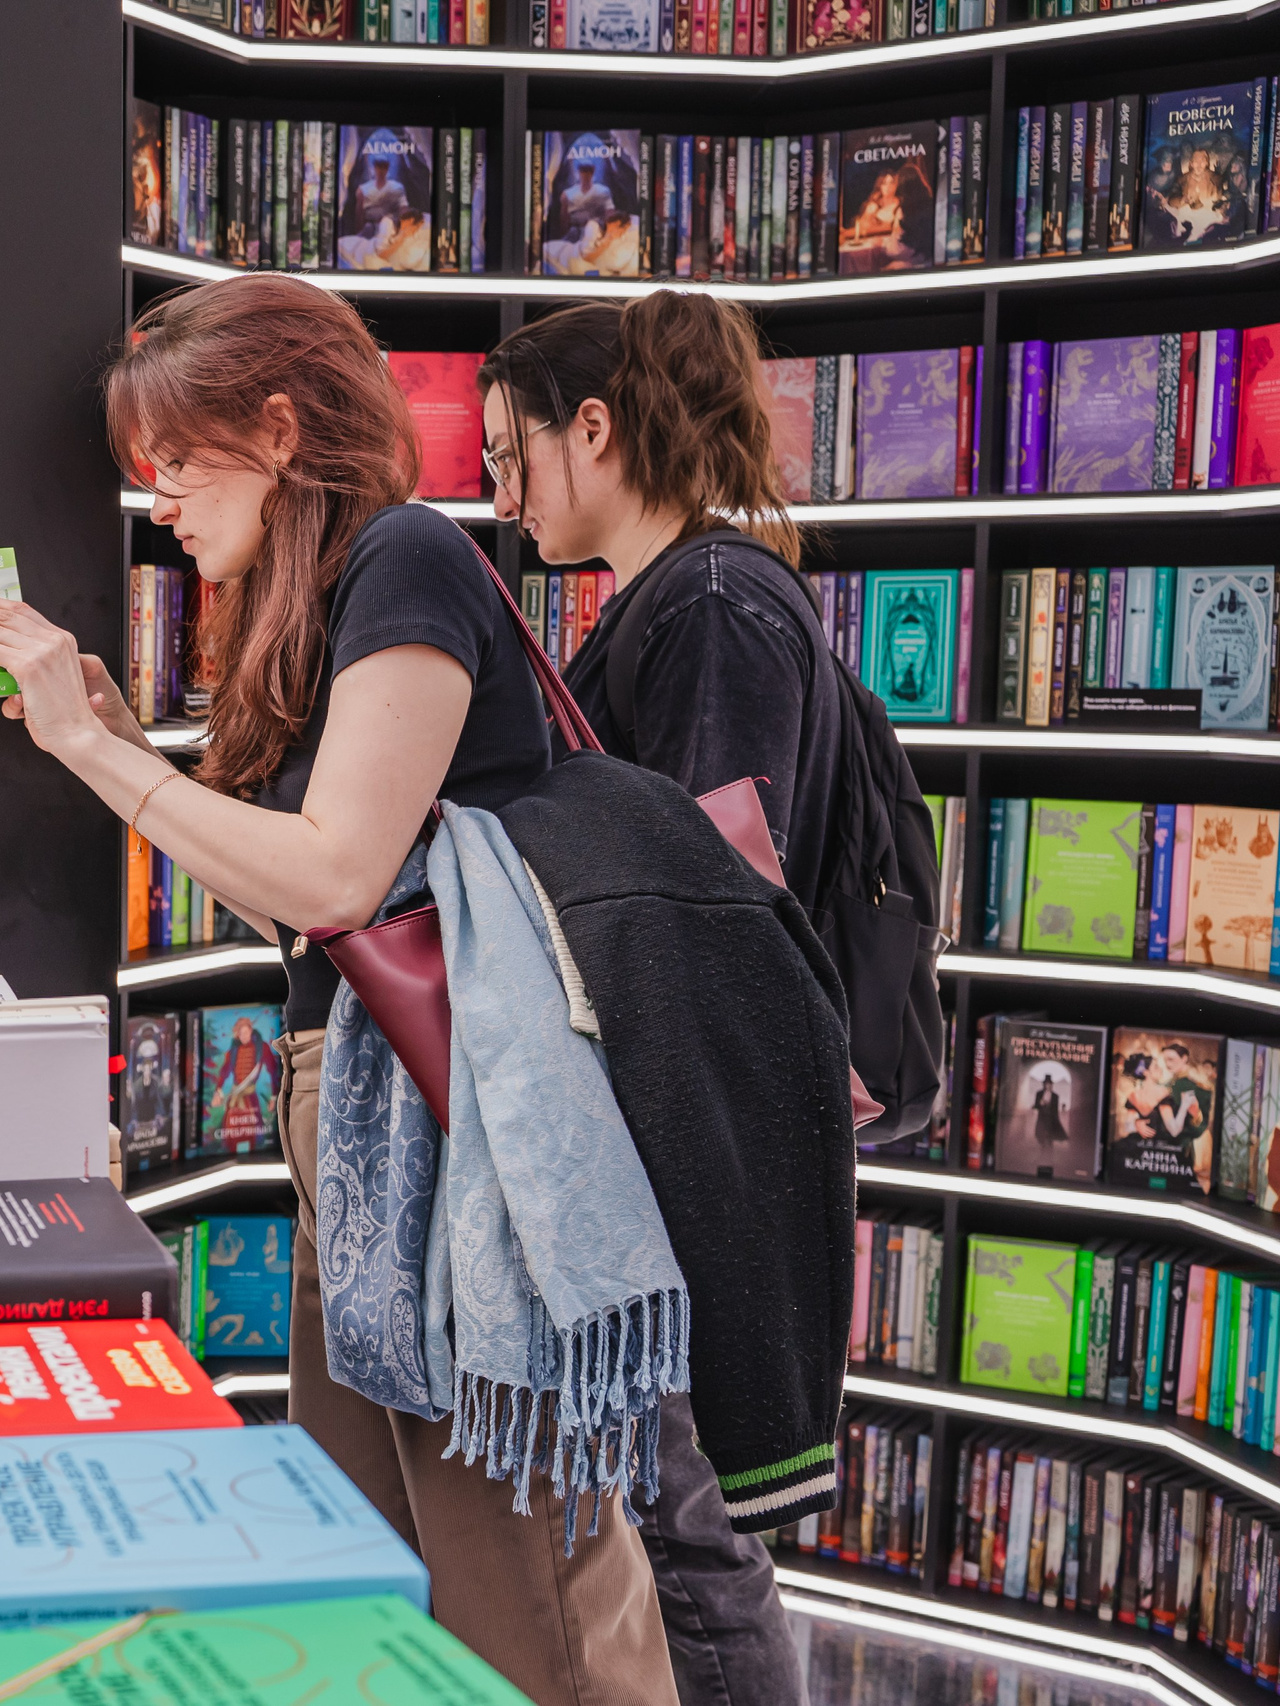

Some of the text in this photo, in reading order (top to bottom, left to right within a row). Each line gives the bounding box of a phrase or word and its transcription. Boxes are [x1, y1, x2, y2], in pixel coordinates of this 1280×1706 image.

[1169, 104, 1234, 124] ПОВЕСТИ
[1169, 119, 1232, 137] БЕЛКИНА
[362, 140, 415, 155] ДЕМОН
[567, 144, 622, 159] ДЕМОН
[853, 143, 926, 164] СВЕТЛАНА
[1010, 1036, 1095, 1056] ПРЕСТУПЛЕНИЕ
[1014, 1048, 1091, 1064] И НАКАЗАНИЕ
[1124, 1157, 1193, 1177] КАРЕНИНА
[1141, 1150, 1178, 1165] АННА
[68, 1299, 109, 1318] РЭЙ
[27, 1326, 122, 1421] проектами
